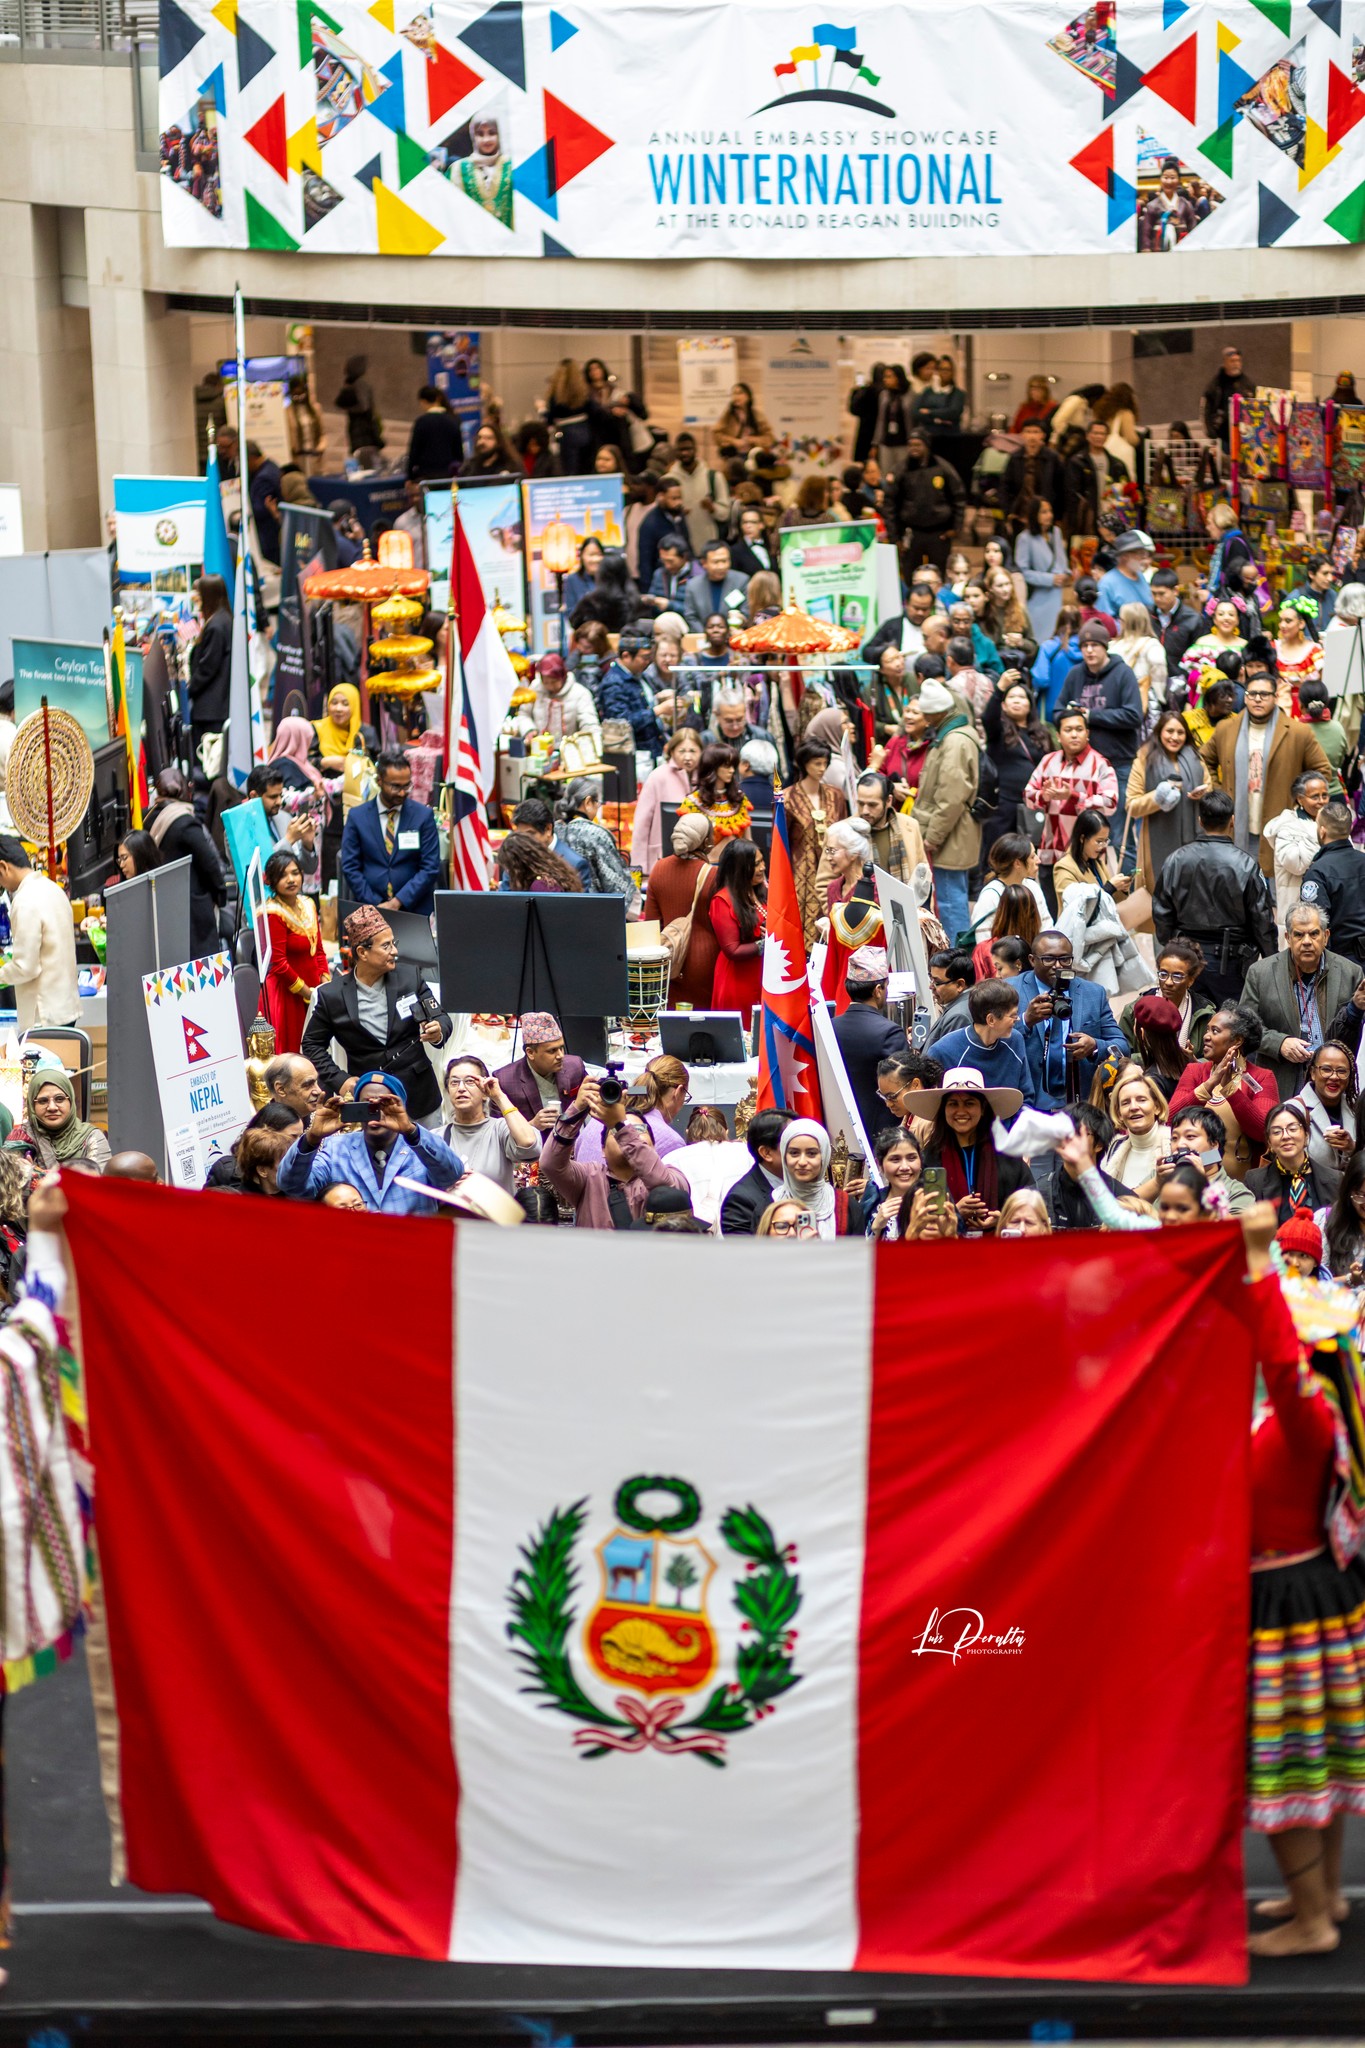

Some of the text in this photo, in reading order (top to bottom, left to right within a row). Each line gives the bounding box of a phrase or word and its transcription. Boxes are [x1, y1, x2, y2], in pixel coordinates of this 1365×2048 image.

[648, 130, 998, 146] ANNUAL EMBASSY SHOWCASE
[648, 153, 1002, 206] WINTERNATIONAL
[655, 213, 1001, 229] AT THE RONALD REAGAN BUILDING
[55, 657, 104, 675] Ceylon Tea
[19, 668, 33, 679] The
[33, 670, 53, 680] finest
[54, 672, 66, 682] tea
[66, 674, 73, 683] in
[74, 675, 87, 684] the
[190, 1070, 216, 1087] EMBASSY OF
[189, 1083, 223, 1114] NEPAL
[176, 1145, 195, 1157] VOTE HERE
